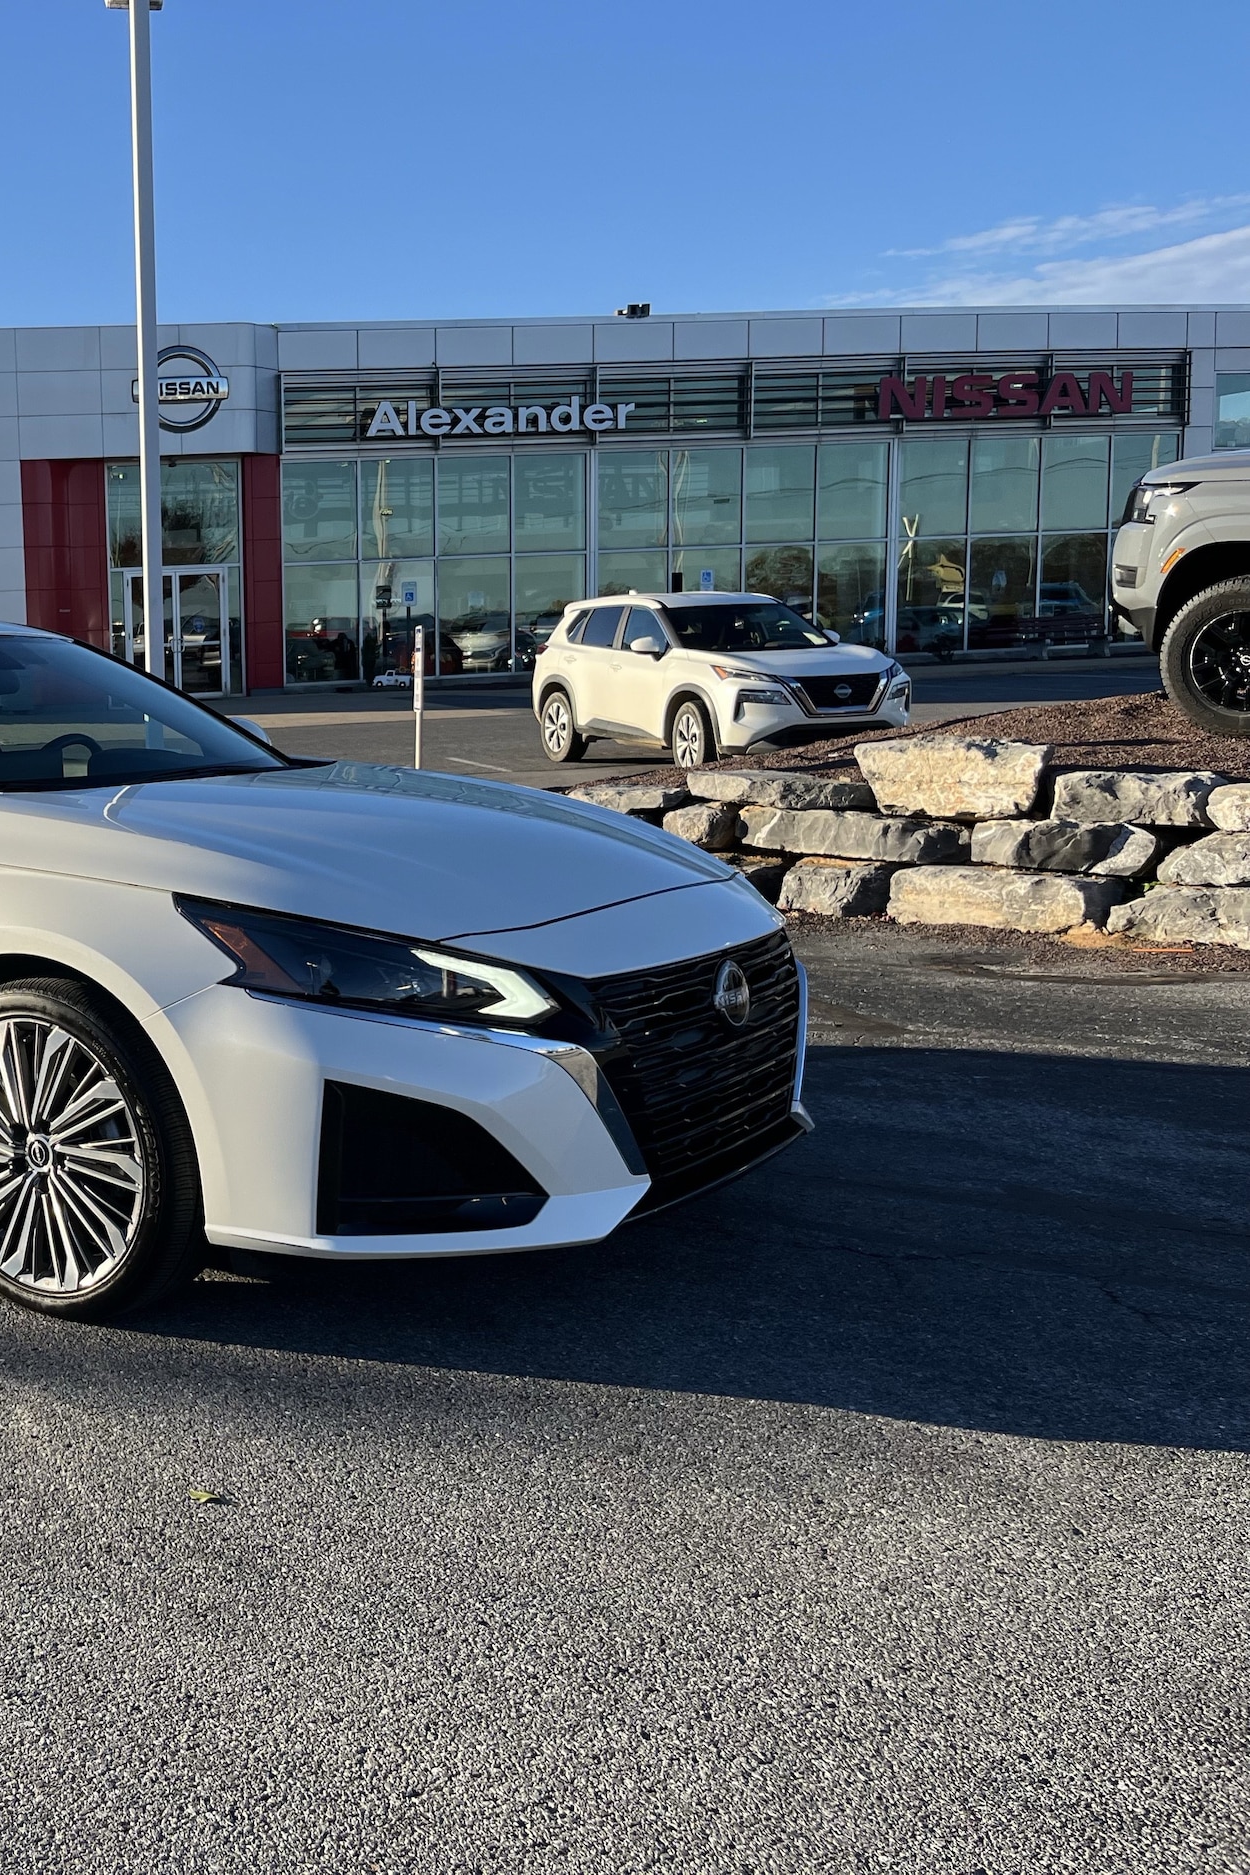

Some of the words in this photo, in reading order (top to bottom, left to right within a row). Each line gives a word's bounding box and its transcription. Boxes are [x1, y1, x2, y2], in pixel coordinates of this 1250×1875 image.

[158, 381, 220, 397] ISSAN
[878, 371, 1134, 420] NISSAN
[366, 395, 636, 437] Alexander
